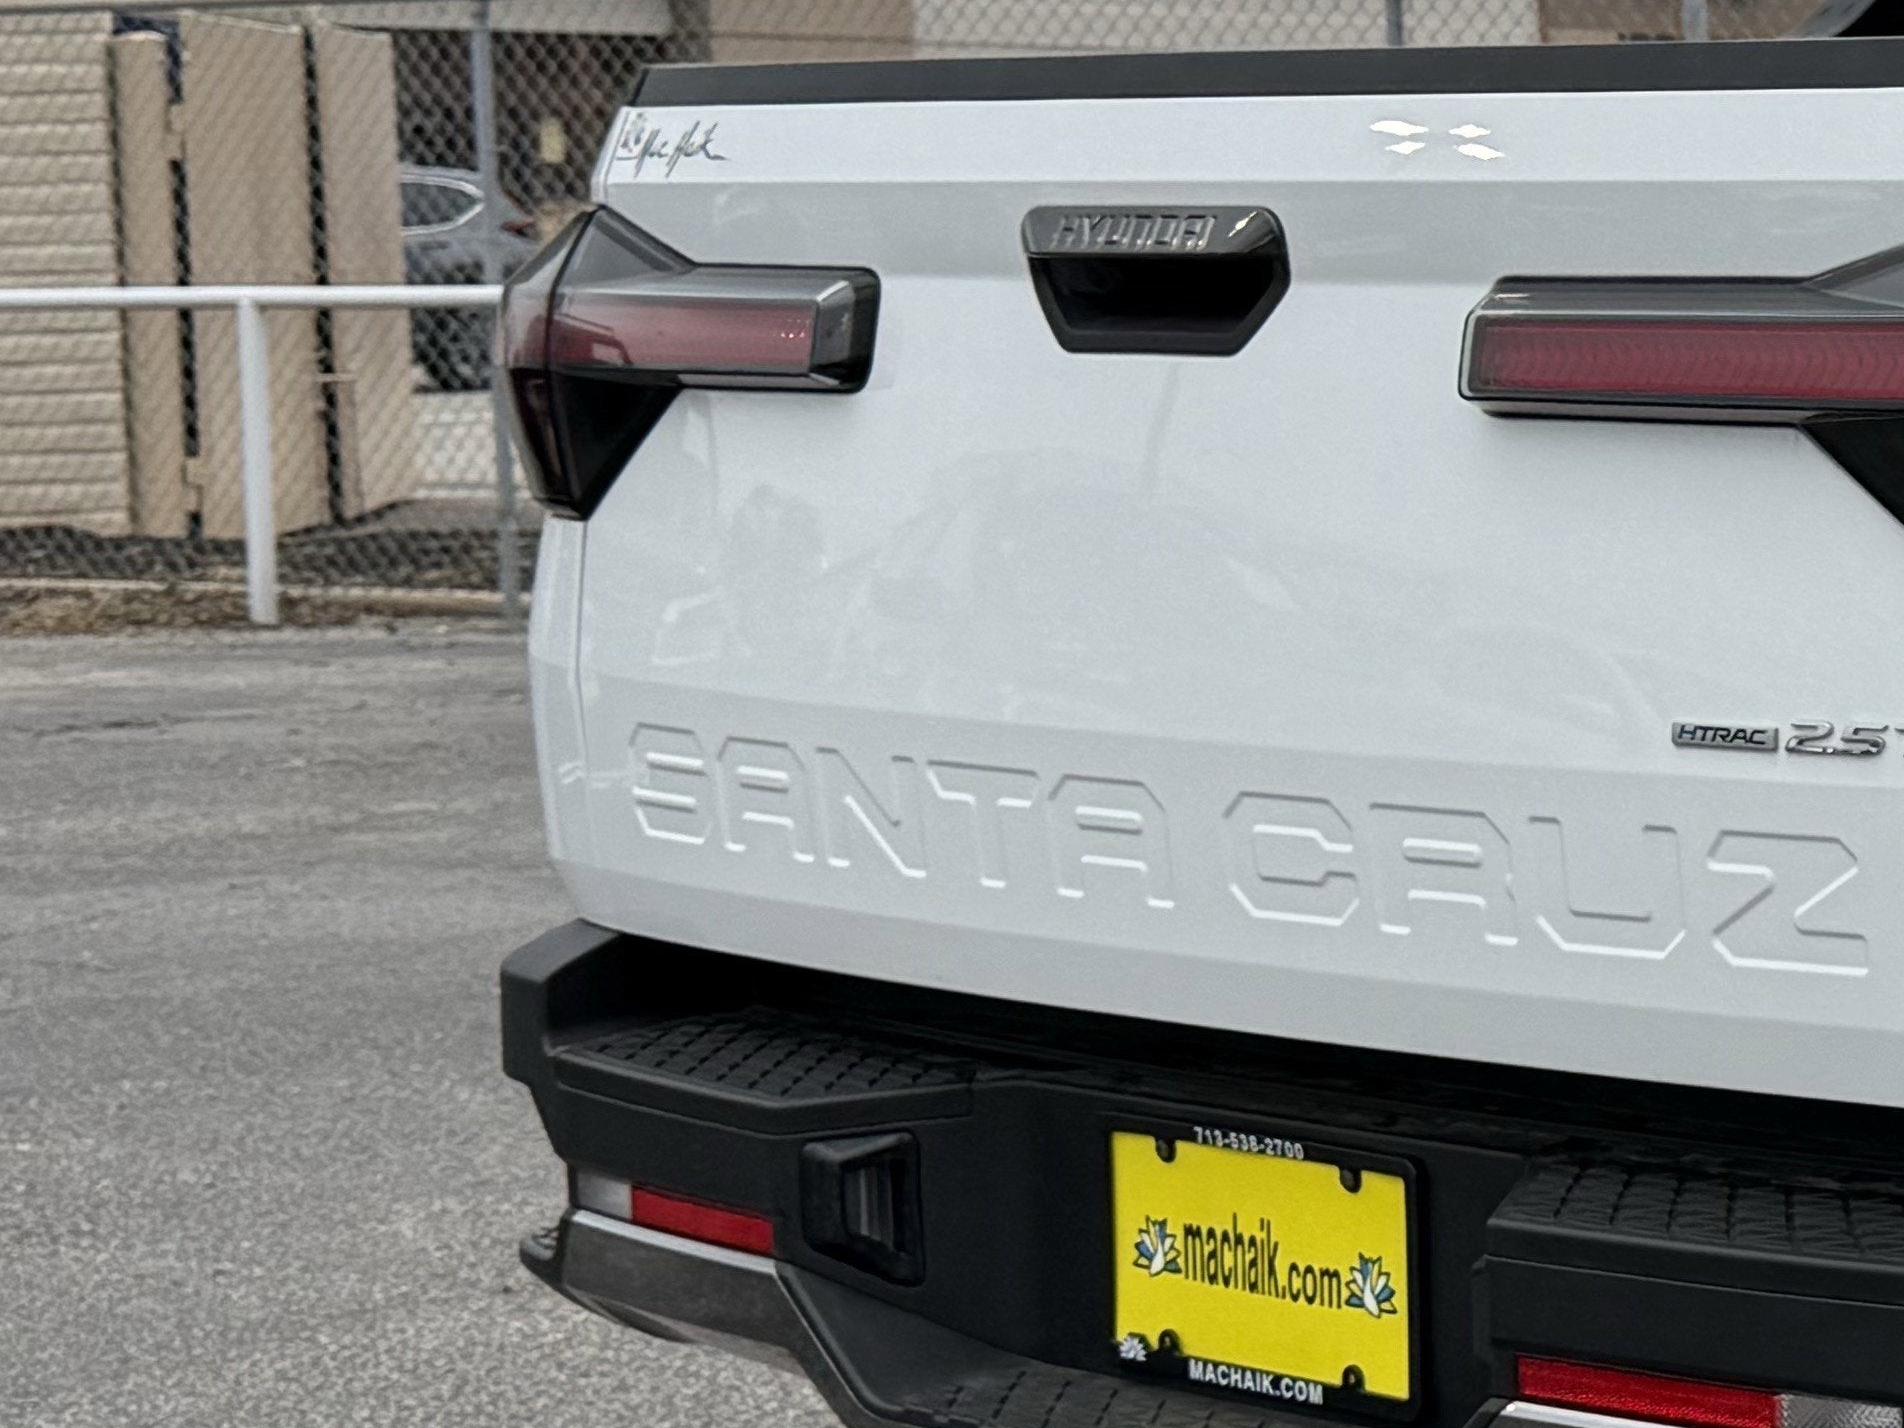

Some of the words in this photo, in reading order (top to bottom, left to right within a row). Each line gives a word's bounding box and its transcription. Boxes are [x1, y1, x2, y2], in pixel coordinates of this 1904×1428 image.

[1046, 213, 1218, 252] HYUNDAI
[1677, 723, 1768, 746] HTRAC
[627, 721, 1176, 909] SANTA
[1222, 790, 1870, 977] CRUZ
[1183, 1213, 1342, 1309] machaik.com
[1189, 1358, 1323, 1405] MACHAIK.COM
